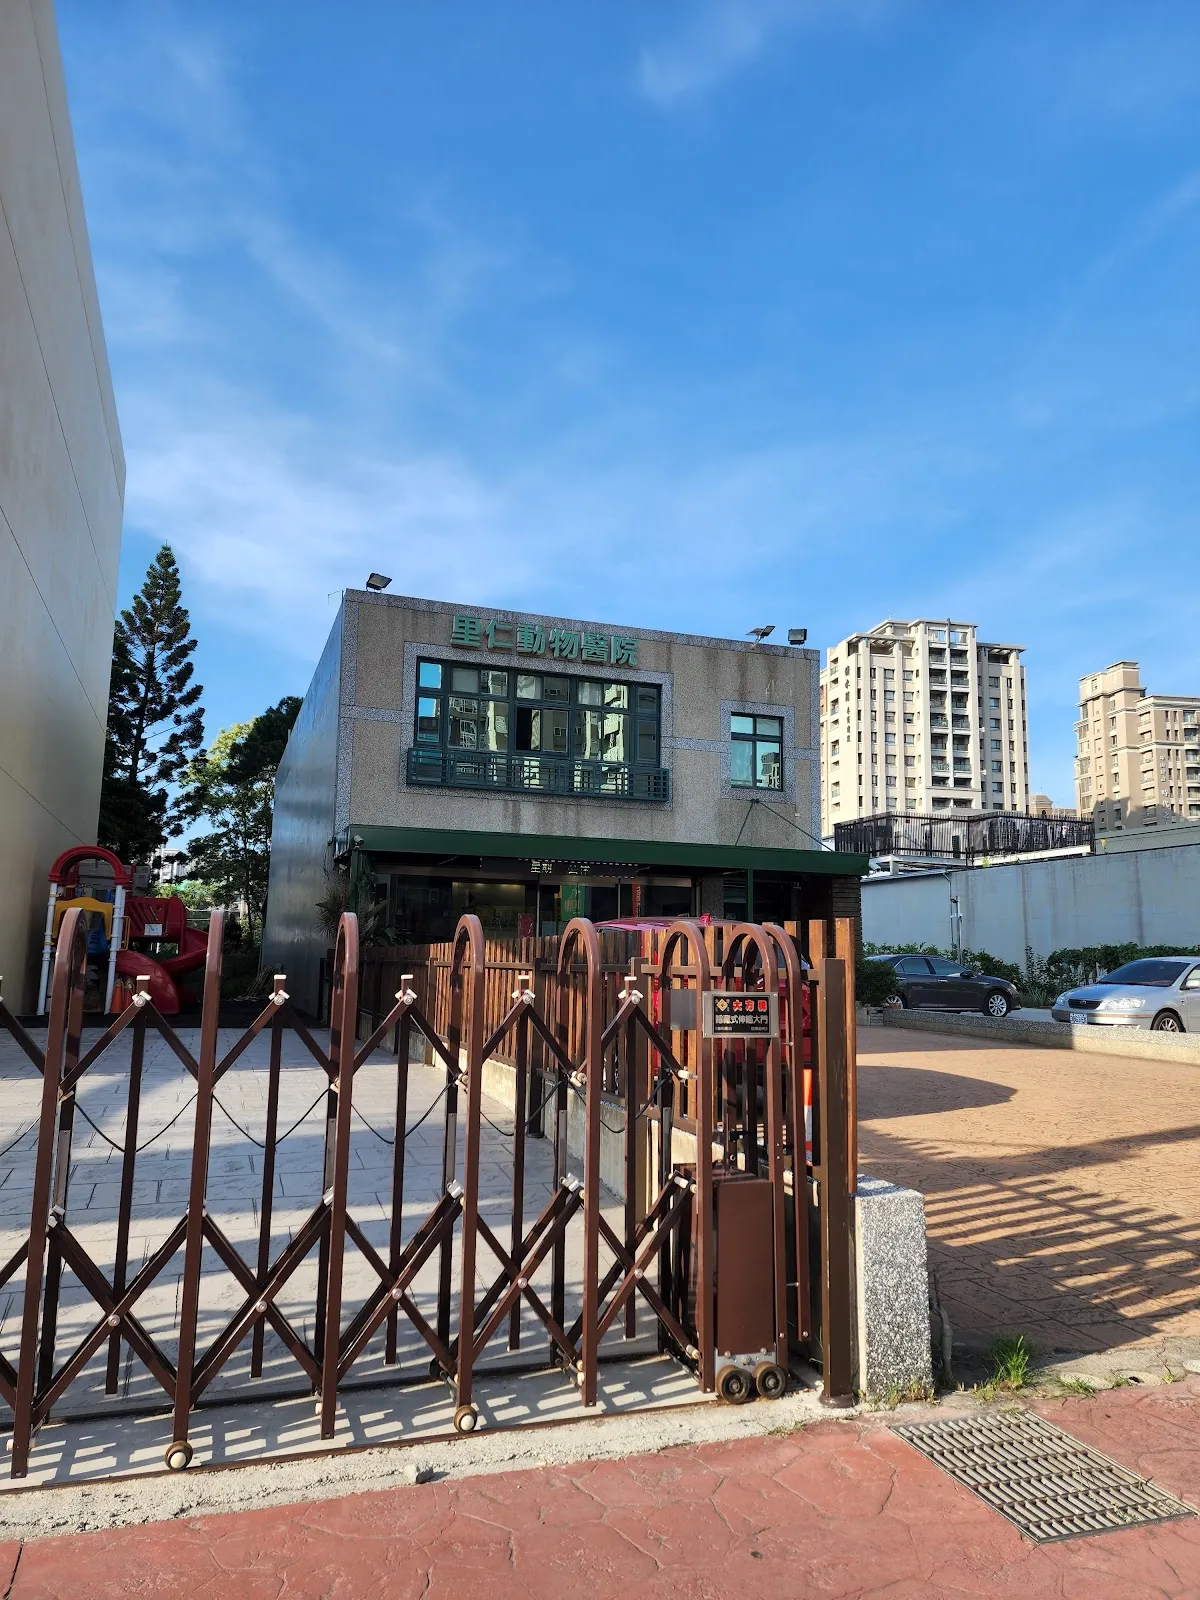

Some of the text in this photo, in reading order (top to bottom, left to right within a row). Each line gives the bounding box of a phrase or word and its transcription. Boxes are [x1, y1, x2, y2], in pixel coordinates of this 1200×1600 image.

[450, 615, 640, 667] 里仁動物醫院
